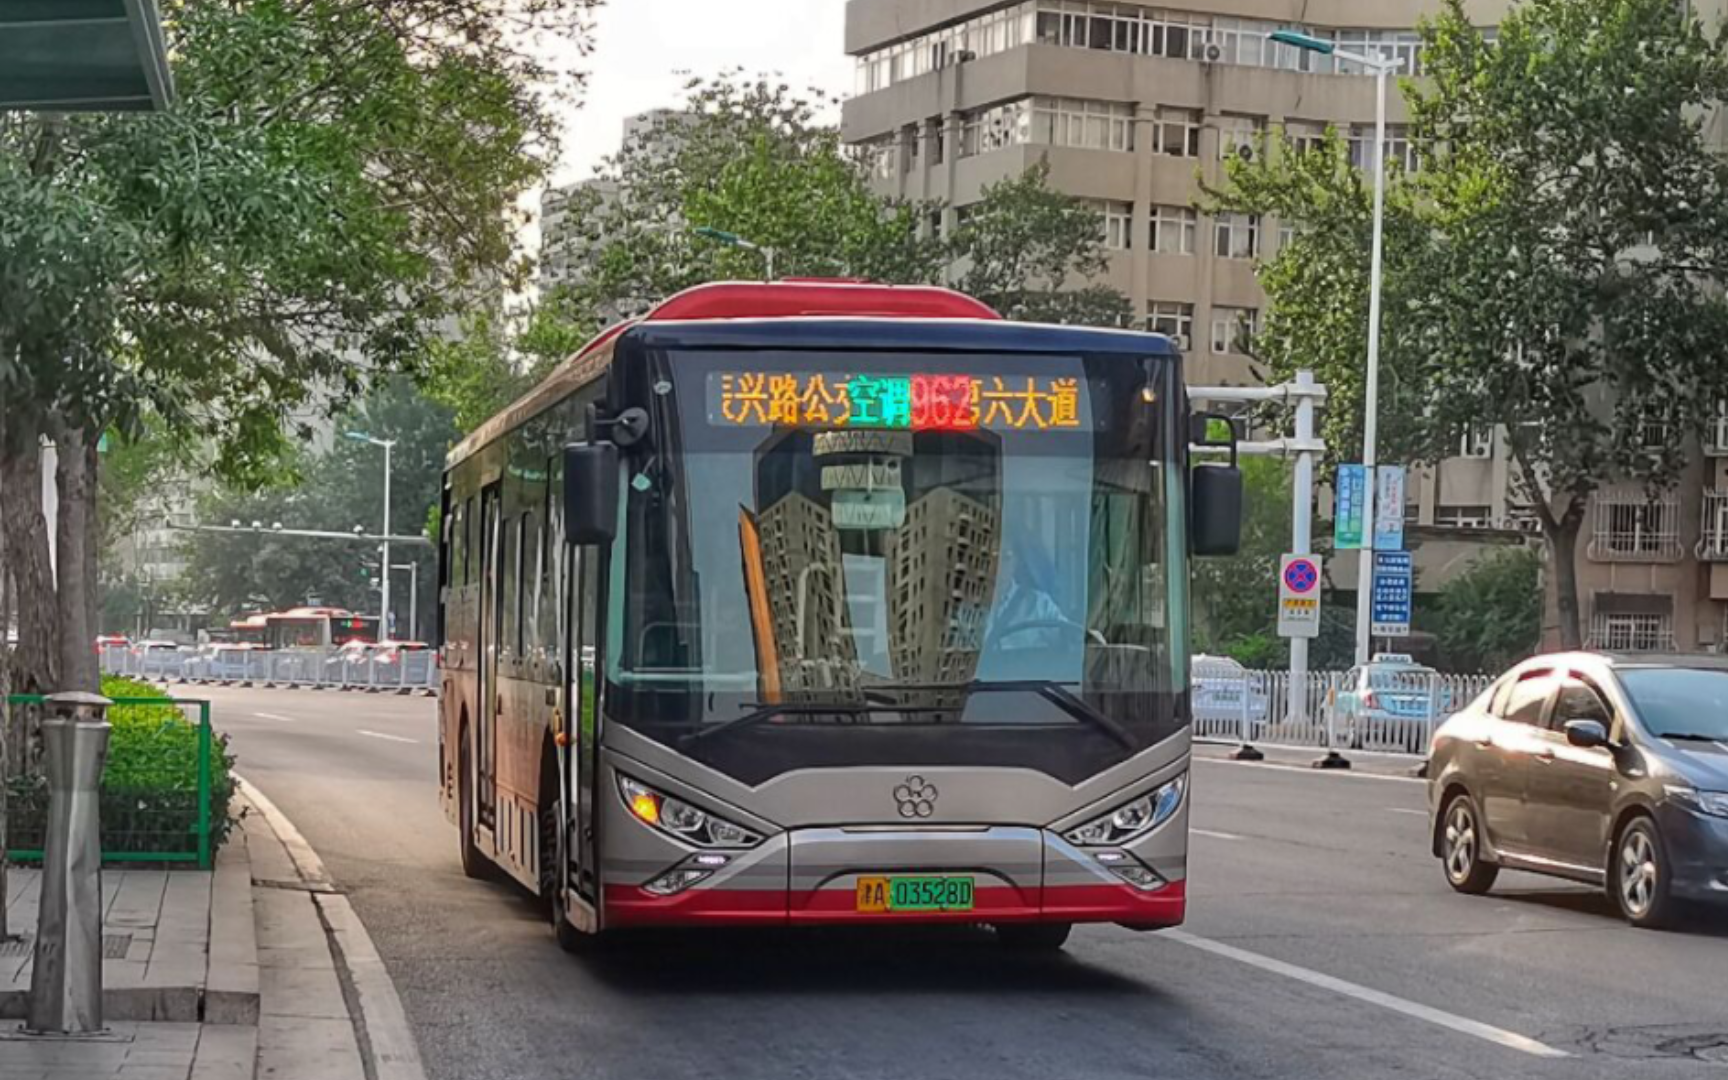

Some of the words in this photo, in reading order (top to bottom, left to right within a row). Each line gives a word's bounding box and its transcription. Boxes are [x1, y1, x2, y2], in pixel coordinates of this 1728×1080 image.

[849, 375, 909, 426] 空调
[912, 376, 971, 426] 962
[896, 881, 971, 905] 03528D
